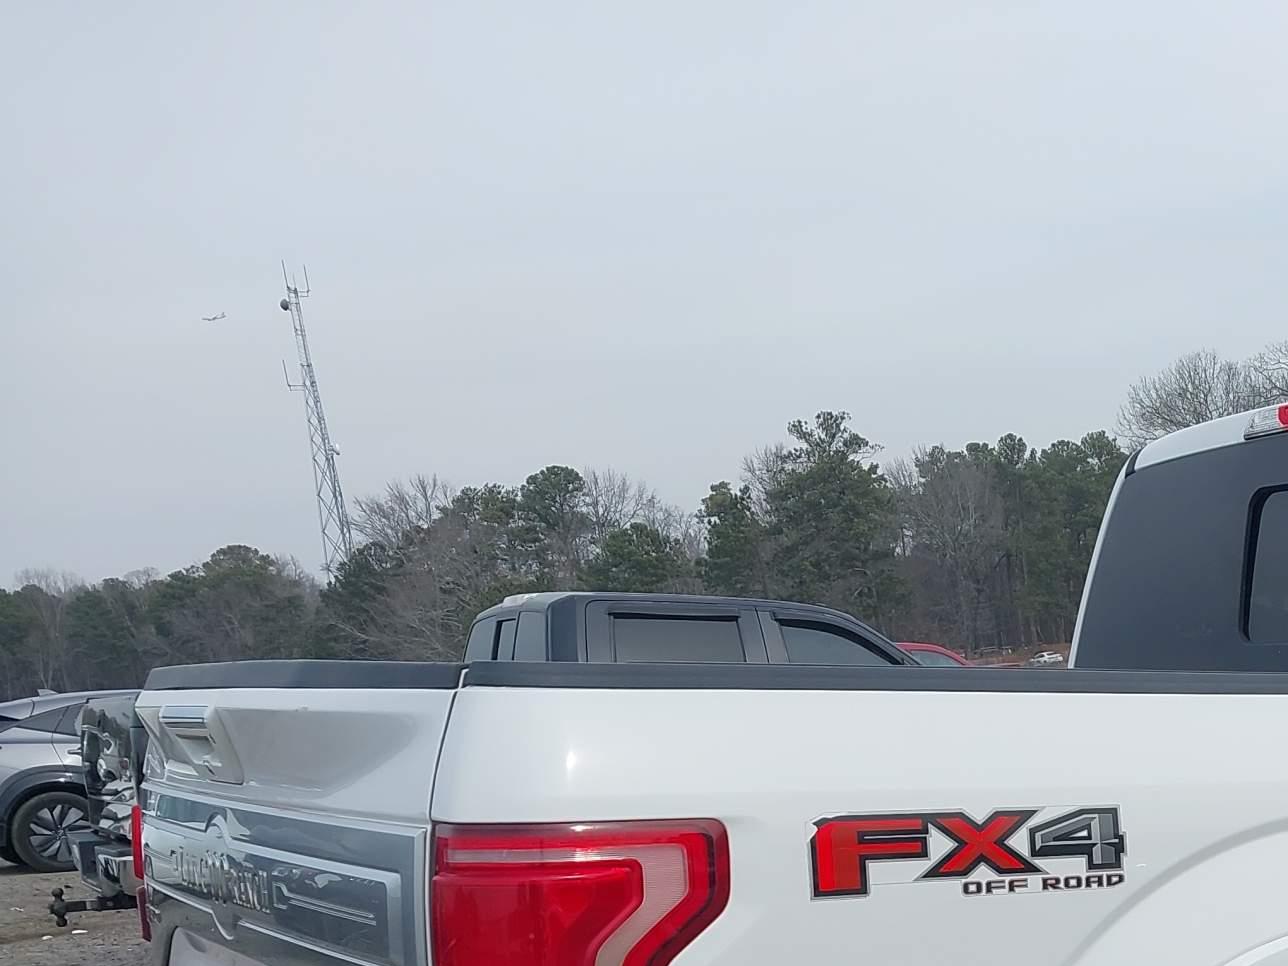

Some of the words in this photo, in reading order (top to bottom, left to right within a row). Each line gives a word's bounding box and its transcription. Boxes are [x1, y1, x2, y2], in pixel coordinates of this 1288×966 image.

[812, 806, 1126, 898] FX4
[962, 879, 1029, 896] OFF
[1041, 873, 1125, 892] ROAD
